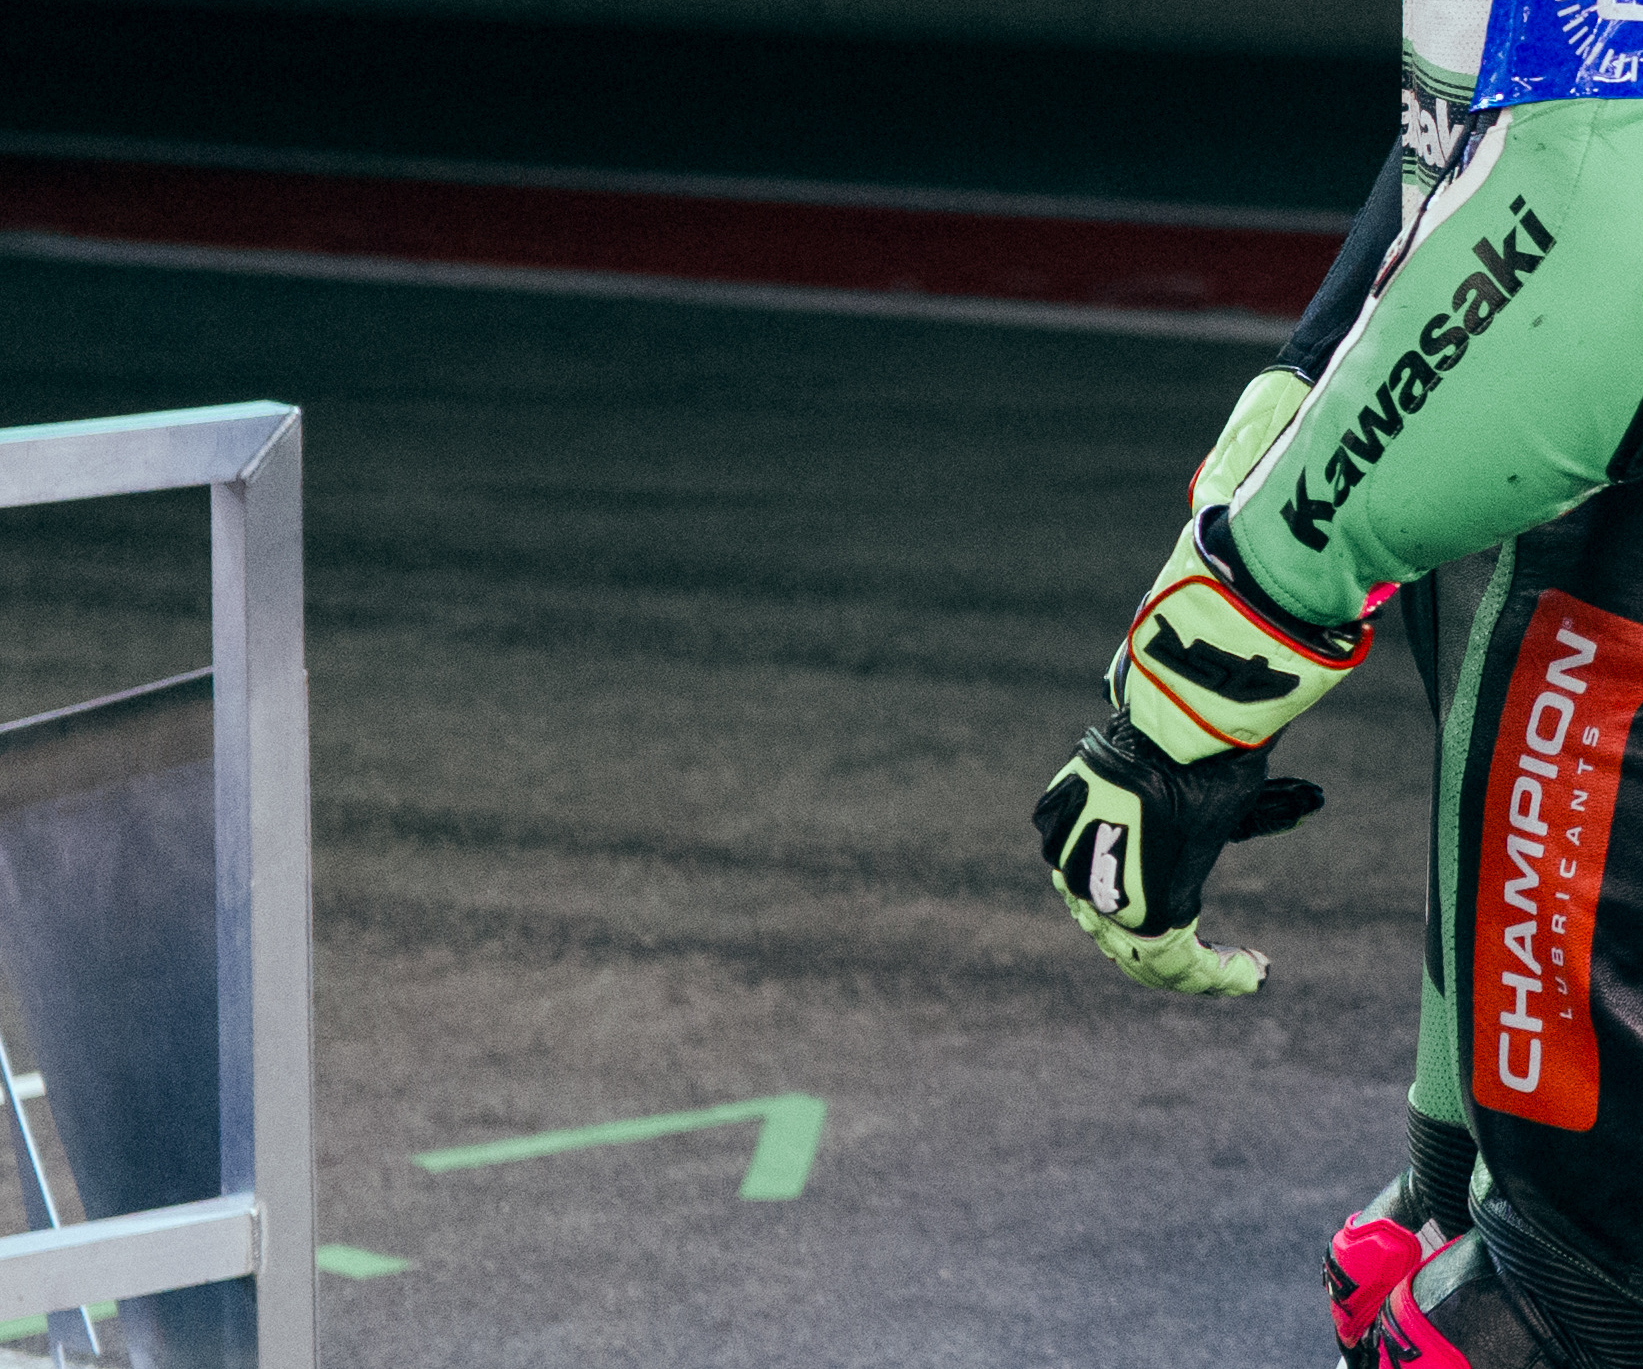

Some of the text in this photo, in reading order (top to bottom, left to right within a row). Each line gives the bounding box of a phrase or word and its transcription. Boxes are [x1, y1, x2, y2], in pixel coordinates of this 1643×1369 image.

[1279, 194, 1557, 553] Kawasaki
[1498, 628, 1598, 1094] CHAMPION
[1551, 725, 1600, 1021] LUBRICANTS
